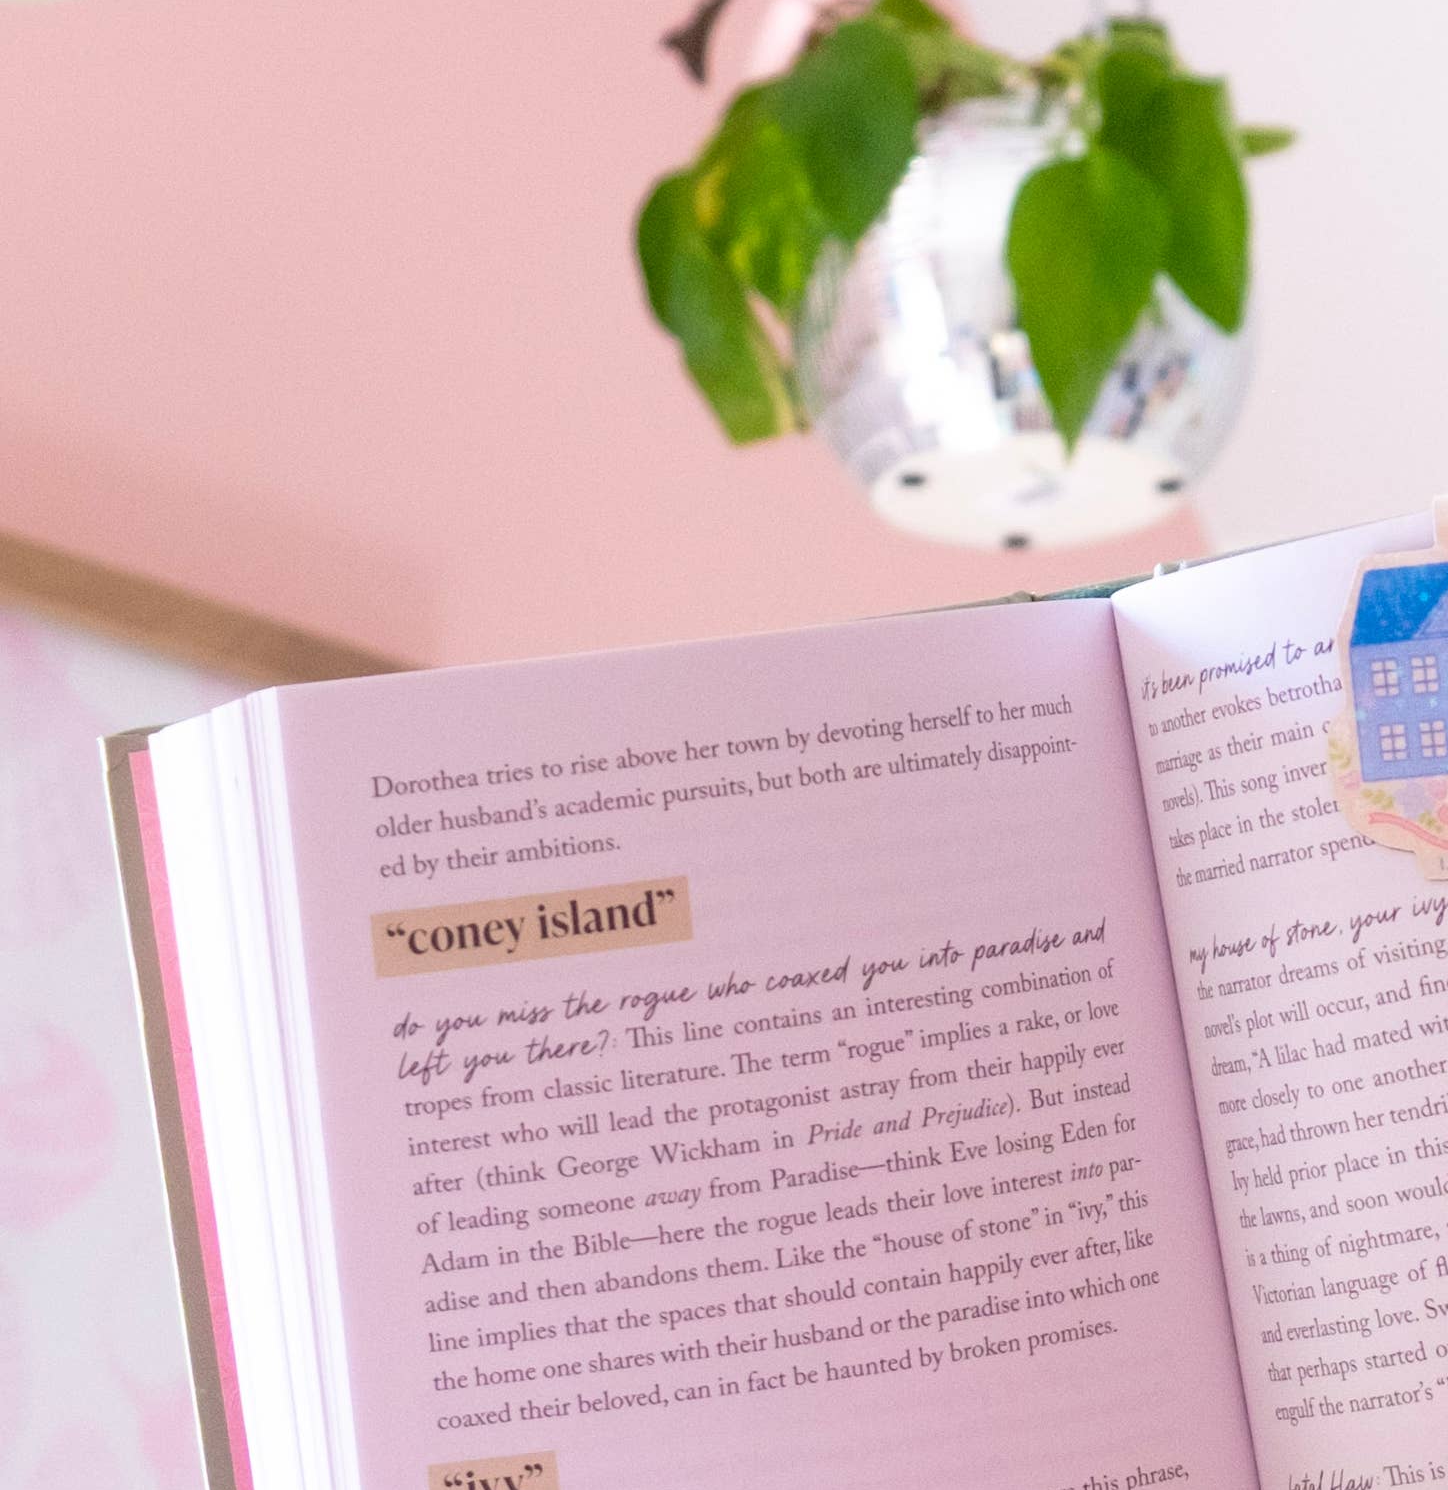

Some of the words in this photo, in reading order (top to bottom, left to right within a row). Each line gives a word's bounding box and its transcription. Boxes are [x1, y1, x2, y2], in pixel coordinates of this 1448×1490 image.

[371, 769, 479, 798] Dorothea
[486, 763, 534, 785] tries
[541, 763, 563, 778] to
[571, 754, 608, 775] rise
[616, 747, 677, 769] above
[684, 740, 720, 761] her
[726, 737, 780, 756] town
[785, 728, 810, 754] by
[817, 718, 905, 744] devoting
[908, 704, 972, 733] herself
[976, 709, 994, 724] to
[998, 701, 1026, 722] her
[1030, 694, 1072, 718] much
[375, 813, 433, 838] older
[555, 788, 655, 817] academic
[662, 777, 753, 812] pursuits,
[756, 771, 792, 792] but
[797, 761, 847, 787] both
[853, 763, 882, 780] are
[888, 744, 982, 775] ultimately
[987, 735, 1077, 765] disappoint-
[380, 854, 407, 878] ed
[412, 853, 439, 880] by
[446, 846, 499, 870] their
[505, 836, 621, 863] ambitions.
[393, 1012, 424, 1040] do
[436, 1015, 487, 1047] you
[497, 1001, 554, 1026] miss
[562, 990, 610, 1020] the
[619, 987, 697, 1022] rogue
[707, 971, 756, 1000] who
[765, 955, 851, 992] coaxed
[862, 958, 909, 991] you
[919, 940, 964, 969] into
[971, 927, 1066, 972] paradise
[1072, 917, 1106, 946] and
[1213, 936, 1257, 959] house
[1261, 924, 1280, 958] of
[1286, 919, 1343, 946] stone,
[1350, 907, 1401, 944] your
[1218, 974, 1271, 996] narrator
[1278, 961, 1339, 985] dreams
[1347, 947, 1366, 971] of
[1373, 938, 1448, 964] visiting
[398, 1048, 452, 1086] left
[463, 1051, 515, 1084] you
[625, 1025, 674, 1049] This
[683, 1021, 723, 1042] line
[733, 1008, 822, 1035] contains
[832, 1006, 857, 1021] an
[866, 986, 974, 1017] interesting
[981, 966, 1092, 999] combination
[1098, 957, 1114, 979] of
[413, 1173, 464, 1196] after
[476, 1161, 547, 1191] (think
[557, 1155, 639, 1178] George
[650, 1137, 761, 1165] Wickham
[773, 1130, 794, 1150] in
[807, 1118, 862, 1145] Pride
[873, 1110, 912, 1135] and
[921, 1093, 1021, 1129] Prejudice).
[1028, 1088, 1064, 1110] But
[1073, 1072, 1131, 1102] instead
[437, 1402, 512, 1430] coaxed
[519, 1398, 571, 1421] their
[577, 1383, 669, 1414] beloved,
[674, 1385, 711, 1402] can
[718, 1377, 740, 1396] in
[747, 1370, 786, 1393] fact
[792, 1365, 818, 1386] be
[824, 1348, 912, 1381] haunted
[918, 1346, 944, 1372] by
[949, 1336, 1021, 1362] broken
[1027, 1320, 1118, 1356] promises.
